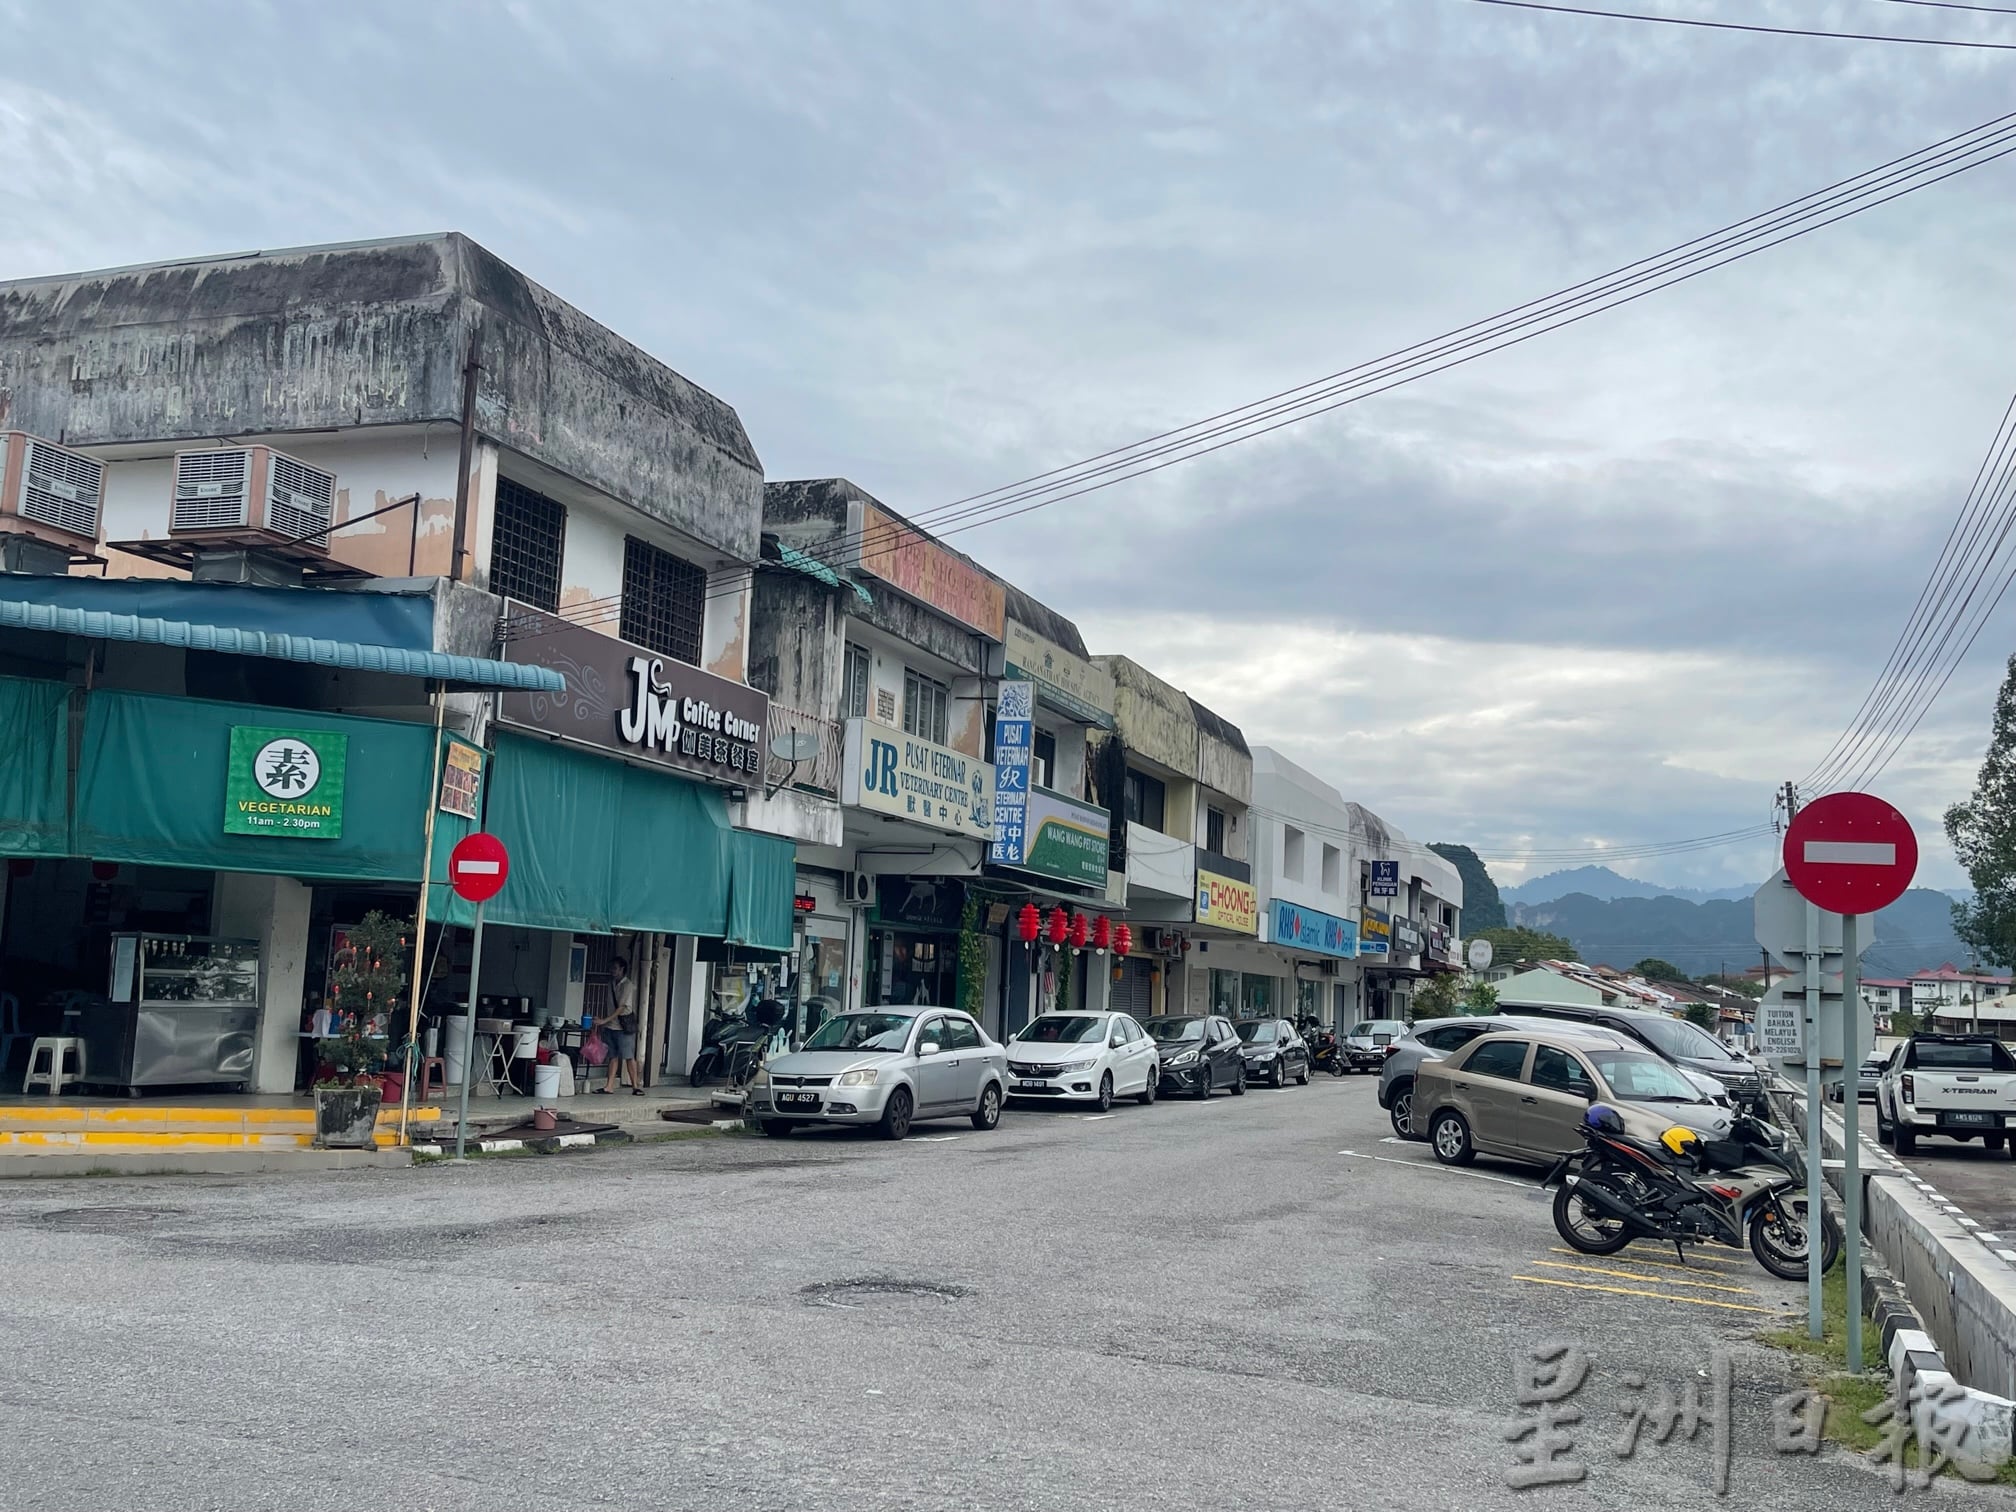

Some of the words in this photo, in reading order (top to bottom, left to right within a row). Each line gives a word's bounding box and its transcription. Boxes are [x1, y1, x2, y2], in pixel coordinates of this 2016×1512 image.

[683, 696, 721, 732] Coffee
[724, 710, 761, 744] Corner
[1003, 724, 1024, 745] PUSAT
[905, 741, 930, 773] PUSAT
[930, 749, 966, 786] VETERINAR
[996, 745, 1030, 767] VETERINAR
[264, 747, 310, 790] 素
[864, 738, 899, 798] JR
[900, 771, 943, 801] VETERINARY
[944, 785, 969, 808] CENTRE
[238, 800, 332, 817] VEGETARIAN
[994, 806, 1023, 824] CENTRE
[246, 815, 275, 827] 11am
[283, 816, 321, 830] 2.30pm
[1047, 826, 1066, 844] WANG
[1066, 830, 1083, 850] WANG
[1083, 836, 1092, 851] PET
[1091, 839, 1106, 856] STORE
[1210, 881, 1250, 915] CHOONG
[1217, 910, 1235, 924] OPTICAL
[1236, 915, 1249, 927] HOUSE
[1278, 906, 1295, 940] RHB
[1300, 915, 1320, 947] Islamic
[1324, 918, 1338, 950] RHB
[1341, 928, 1353, 955] Bank
[1767, 1009, 1794, 1018] TUITION
[1767, 1019, 1795, 1027] BAHASA
[1764, 1028, 1792, 1037] MELAYU
[1767, 1037, 1796, 1046] ENGLISH
[782, 1093, 795, 1102] AGU
[797, 1093, 815, 1103] 4527
